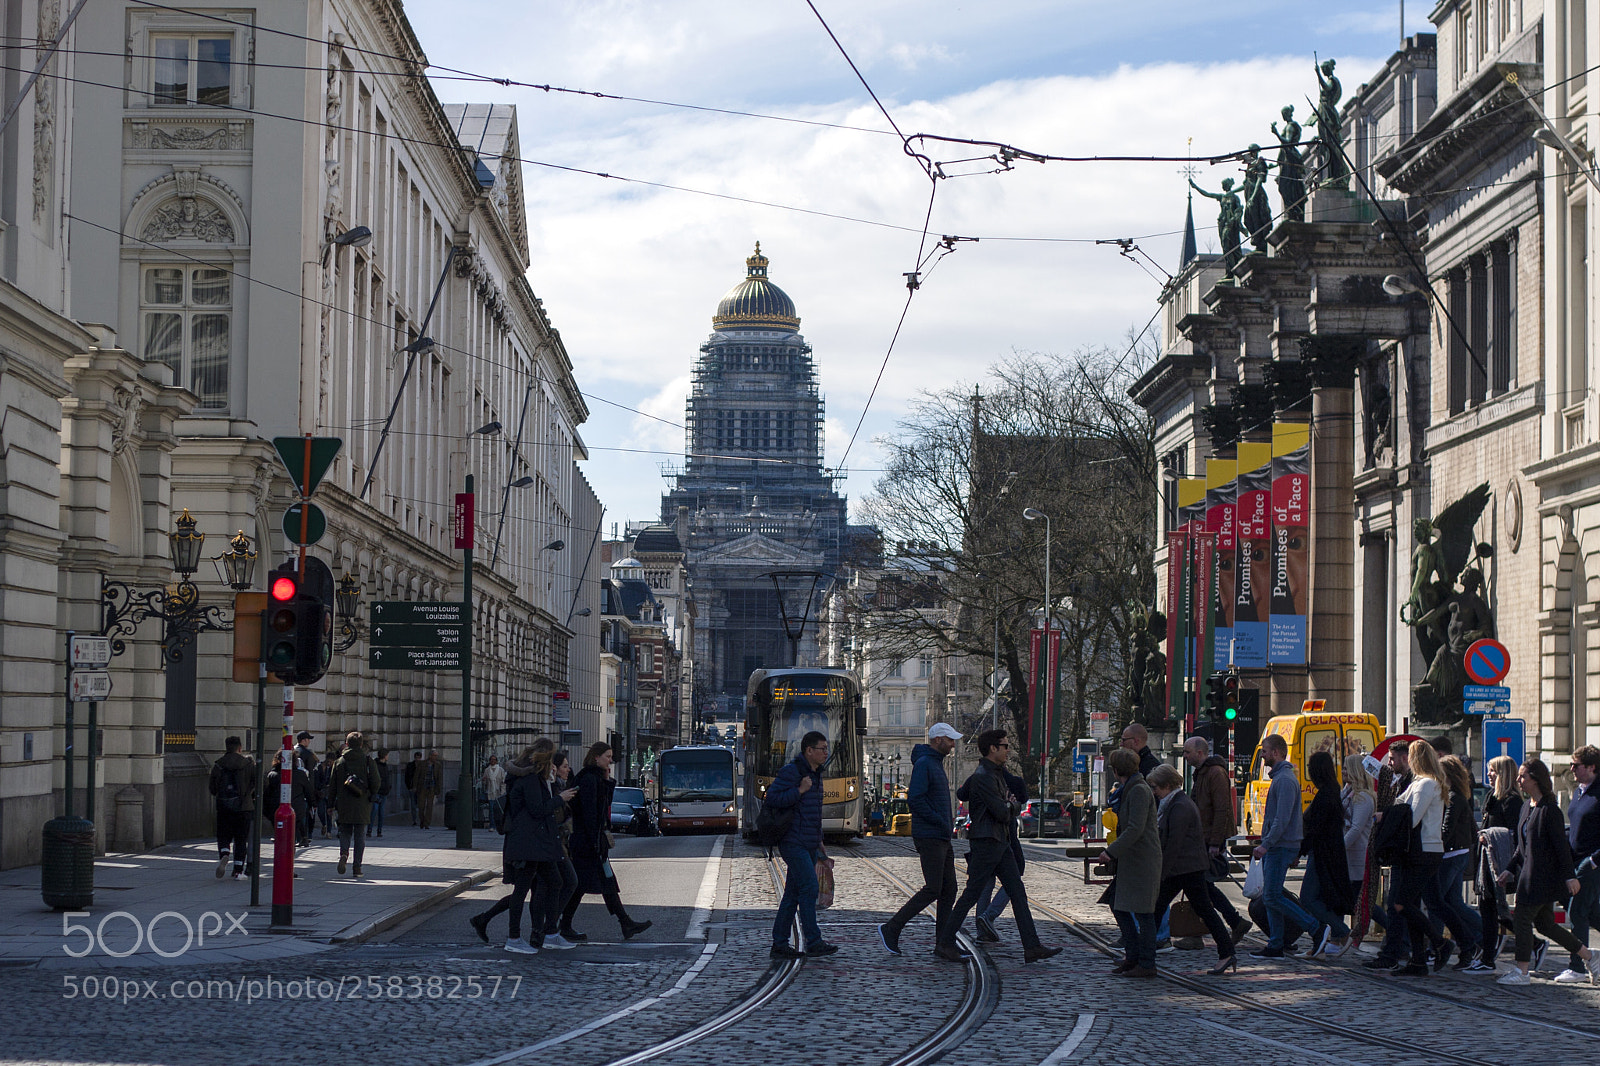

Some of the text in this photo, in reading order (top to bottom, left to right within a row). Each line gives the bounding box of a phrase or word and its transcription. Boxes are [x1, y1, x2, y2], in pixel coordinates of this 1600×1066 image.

[1252, 493, 1264, 535] a Face
[1288, 477, 1302, 522] a Face
[1220, 507, 1232, 536] Face
[1238, 520, 1252, 606] Promises of
[1274, 506, 1288, 598] Promises of
[1309, 714, 1364, 724] GLACES
